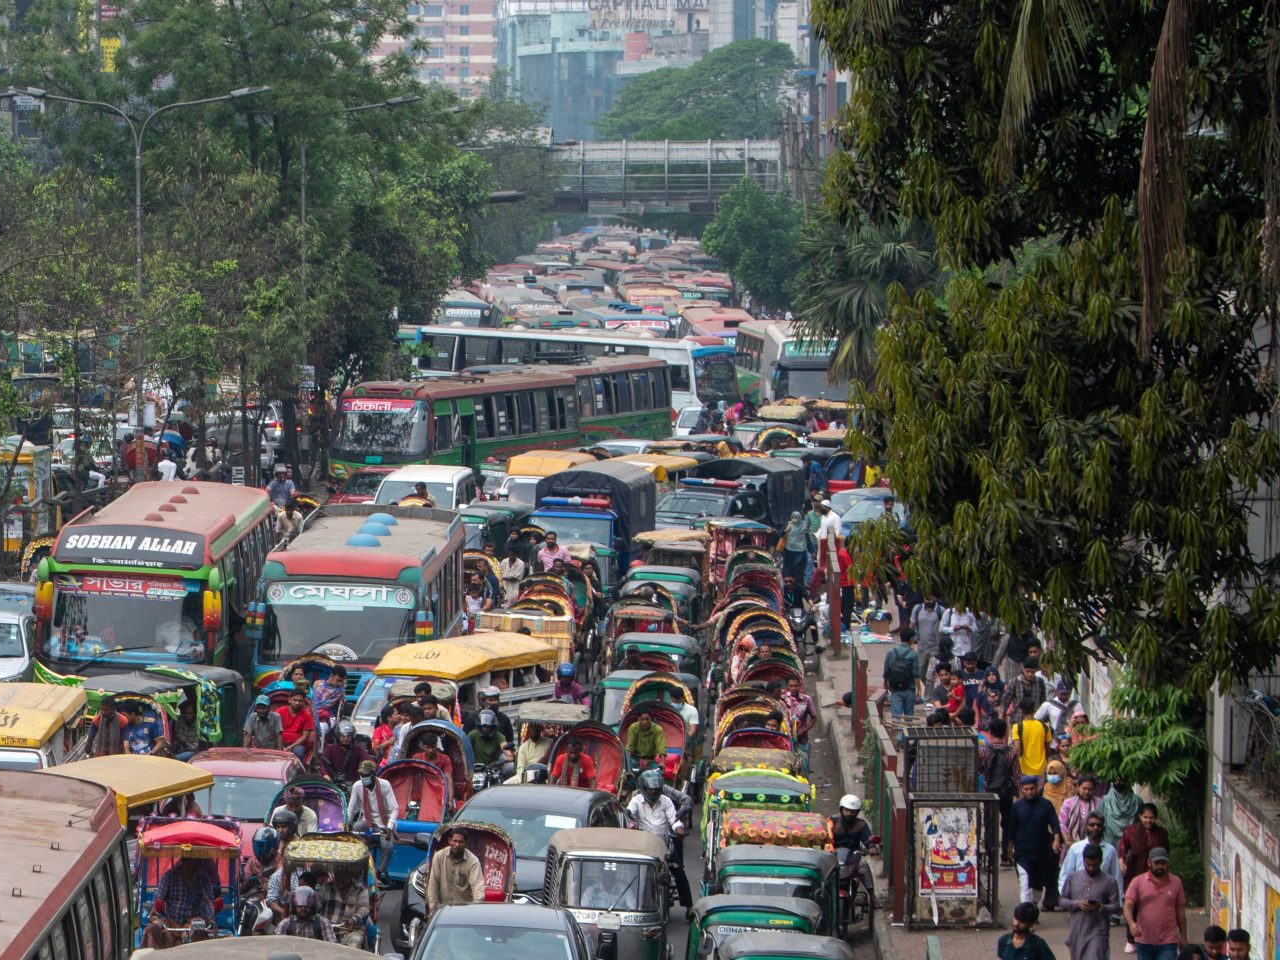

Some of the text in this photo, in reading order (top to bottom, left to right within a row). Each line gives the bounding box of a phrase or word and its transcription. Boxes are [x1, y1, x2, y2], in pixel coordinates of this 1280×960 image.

[351, 400, 392, 412] ঠিকানা
[66, 534, 197, 555] SOBHAN ALLAH
[86, 576, 146, 595] সাভার
[288, 584, 395, 602] মেঘলা
